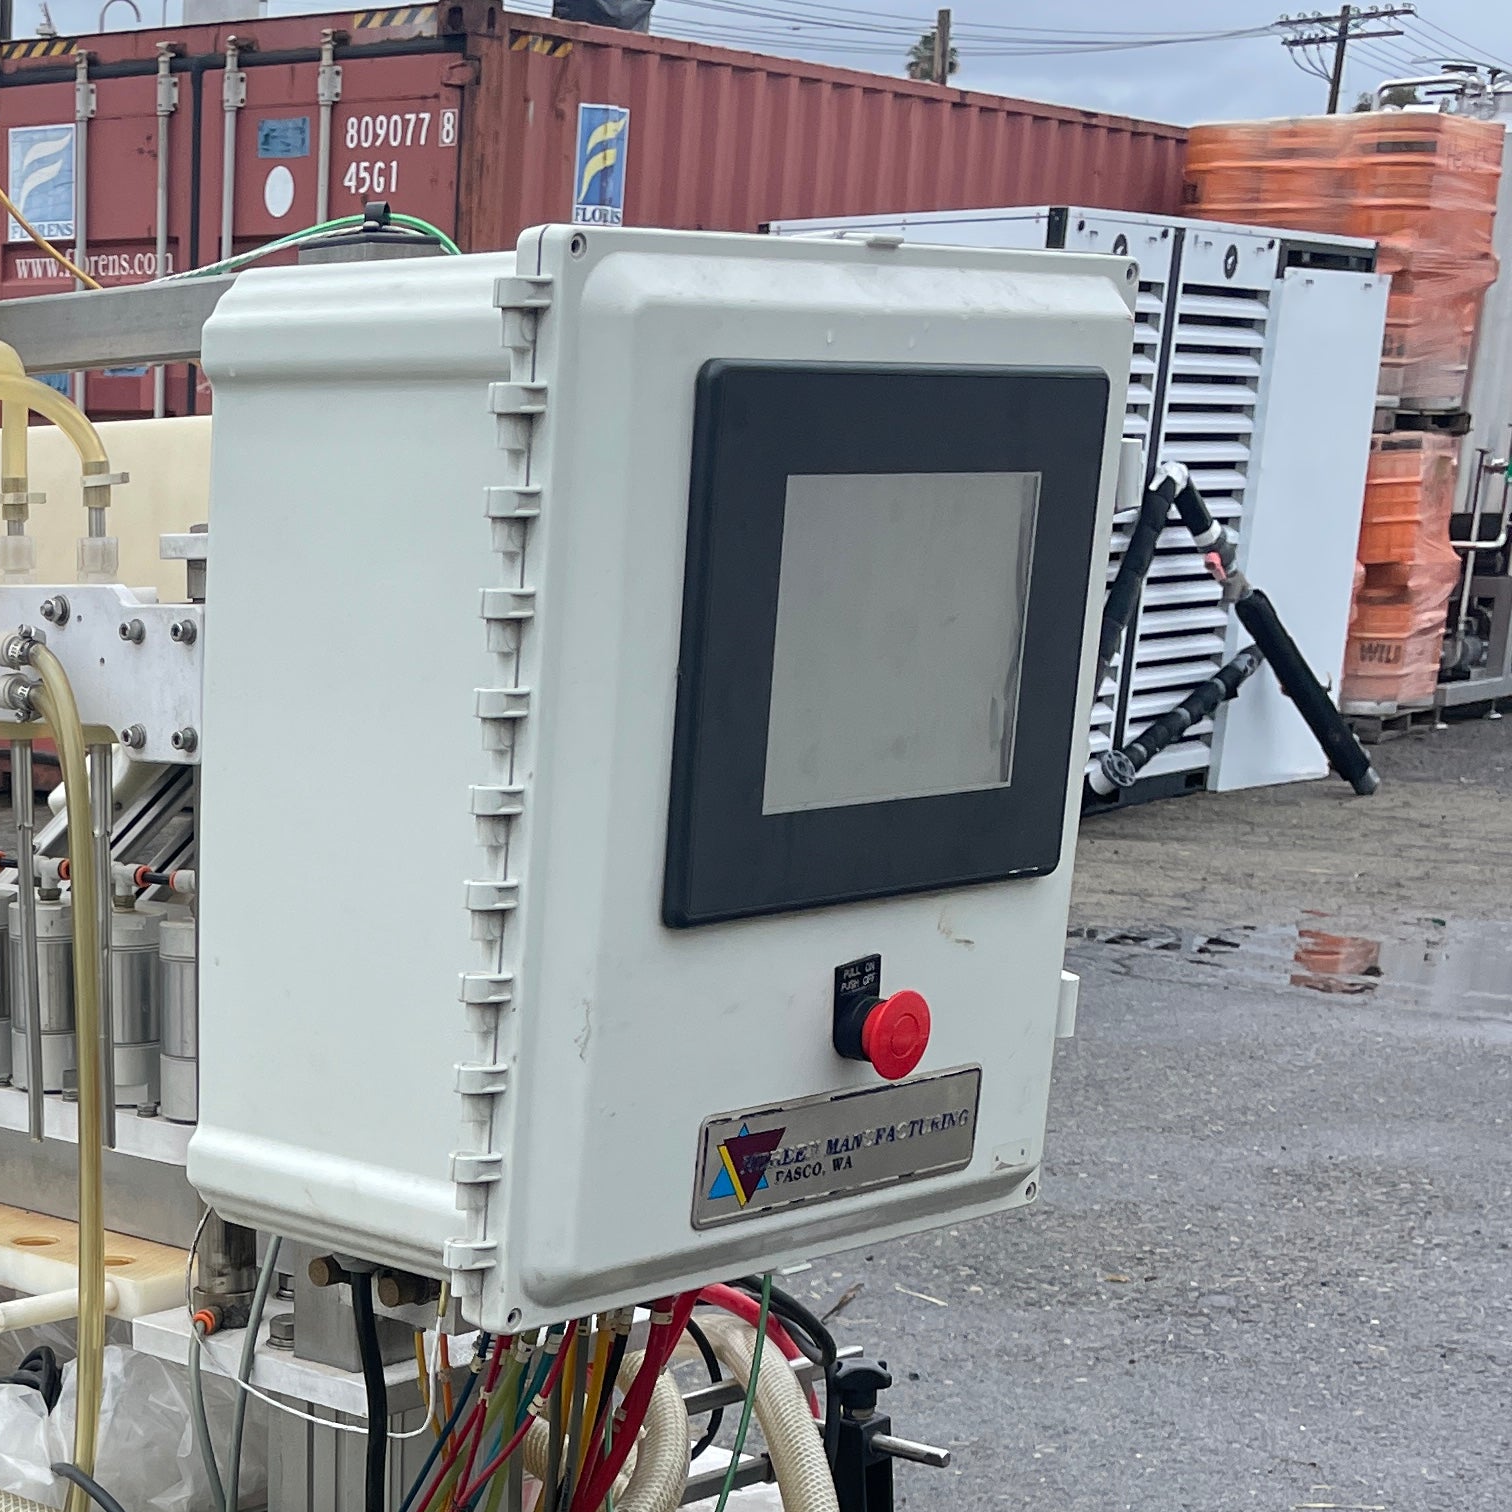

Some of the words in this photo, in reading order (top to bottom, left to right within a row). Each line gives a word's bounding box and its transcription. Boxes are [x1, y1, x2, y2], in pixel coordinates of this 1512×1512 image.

[346, 112, 431, 149] 809077
[442, 111, 455, 144] 8
[343, 160, 398, 194] 45G1
[15, 248, 174, 279] www.frens.com
[831, 1156, 854, 1172] WA
